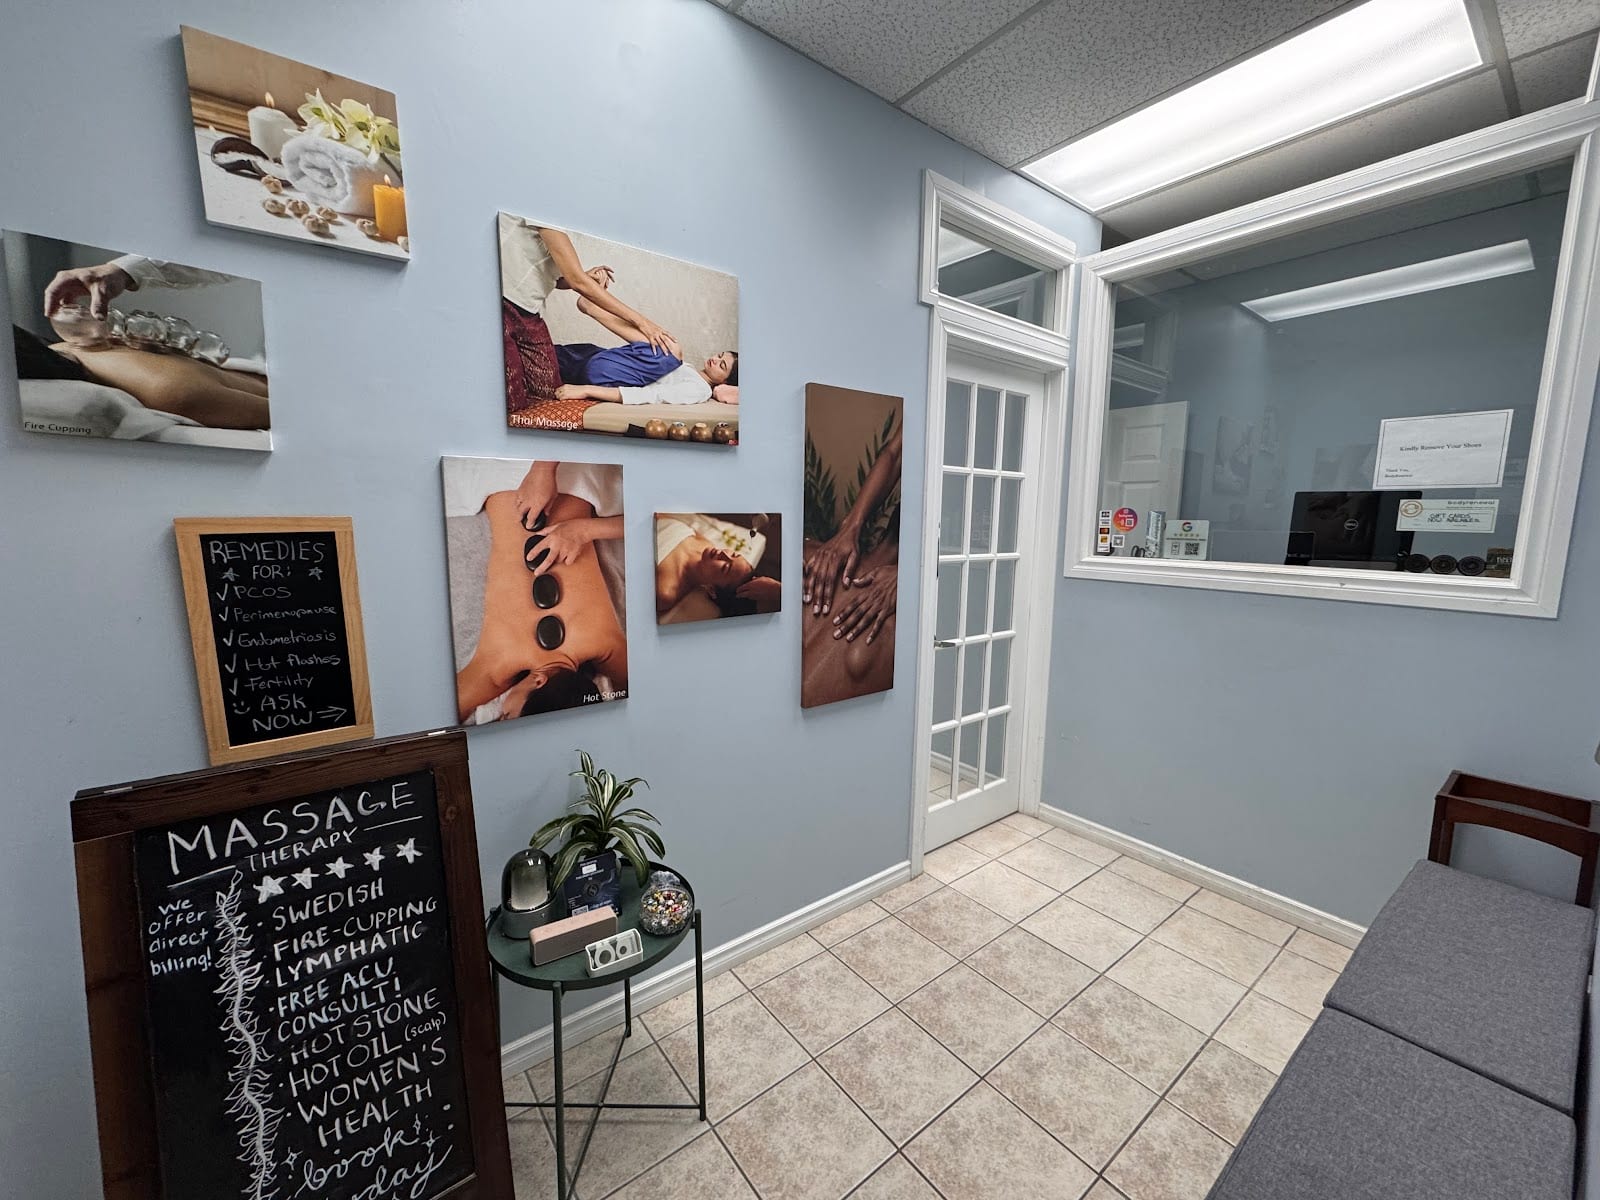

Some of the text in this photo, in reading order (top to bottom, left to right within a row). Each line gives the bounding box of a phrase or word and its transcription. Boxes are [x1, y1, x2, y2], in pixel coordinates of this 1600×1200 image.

[24, 421, 92, 434] Fire Cupping
[511, 414, 579, 431] Thai Massage
[209, 540, 326, 564] REMEDIES
[252, 564, 292, 580] FOR:
[233, 585, 292, 599] PCOS
[245, 675, 314, 692] Fertility
[583, 690, 627, 703] Hot Stone
[260, 693, 307, 712] ASK
[252, 710, 313, 732] NOW
[167, 782, 415, 876] MASSAGE
[244, 826, 359, 872] THERAPY
[272, 877, 385, 931] SWEDISH
[149, 909, 208, 935] offer
[273, 896, 438, 963] FIRE-CUPPING
[149, 927, 209, 953] direct
[274, 920, 424, 988] LYMPHATIC
[150, 949, 212, 977] billing!
[277, 979, 330, 1018] FREE
[277, 976, 402, 1043] CONSULT!
[290, 987, 442, 1066] HOT STONE
[288, 1012, 447, 1098] HOT OIL (scalp)
[297, 1036, 447, 1126] WOMEN'S
[318, 1078, 433, 1148] HEALTH
[352, 1145, 453, 1200] day
